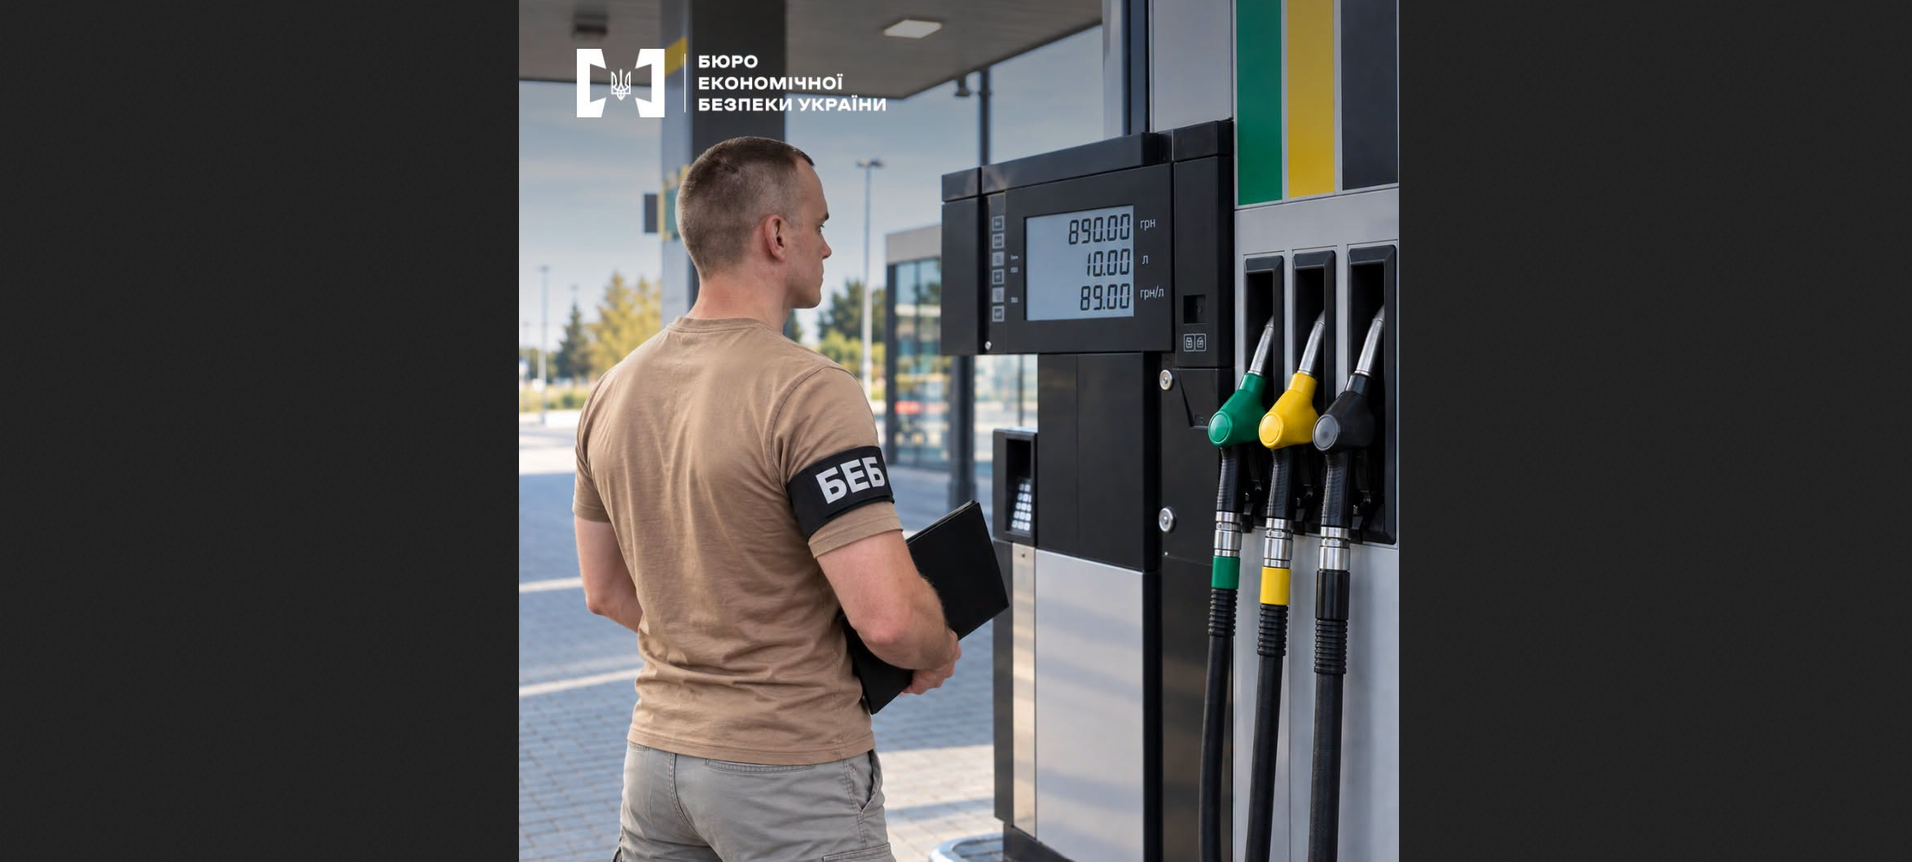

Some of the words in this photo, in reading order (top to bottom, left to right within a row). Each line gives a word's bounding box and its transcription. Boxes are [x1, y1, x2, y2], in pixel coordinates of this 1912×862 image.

[1068, 213, 1131, 245] 890.00
[1140, 218, 1156, 231] грн
[1086, 248, 1131, 277] 10.00
[1141, 255, 1149, 265] л
[1080, 283, 1131, 311] 89.00
[1140, 285, 1164, 299] грн/л
[815, 457, 885, 504] БЕБ
